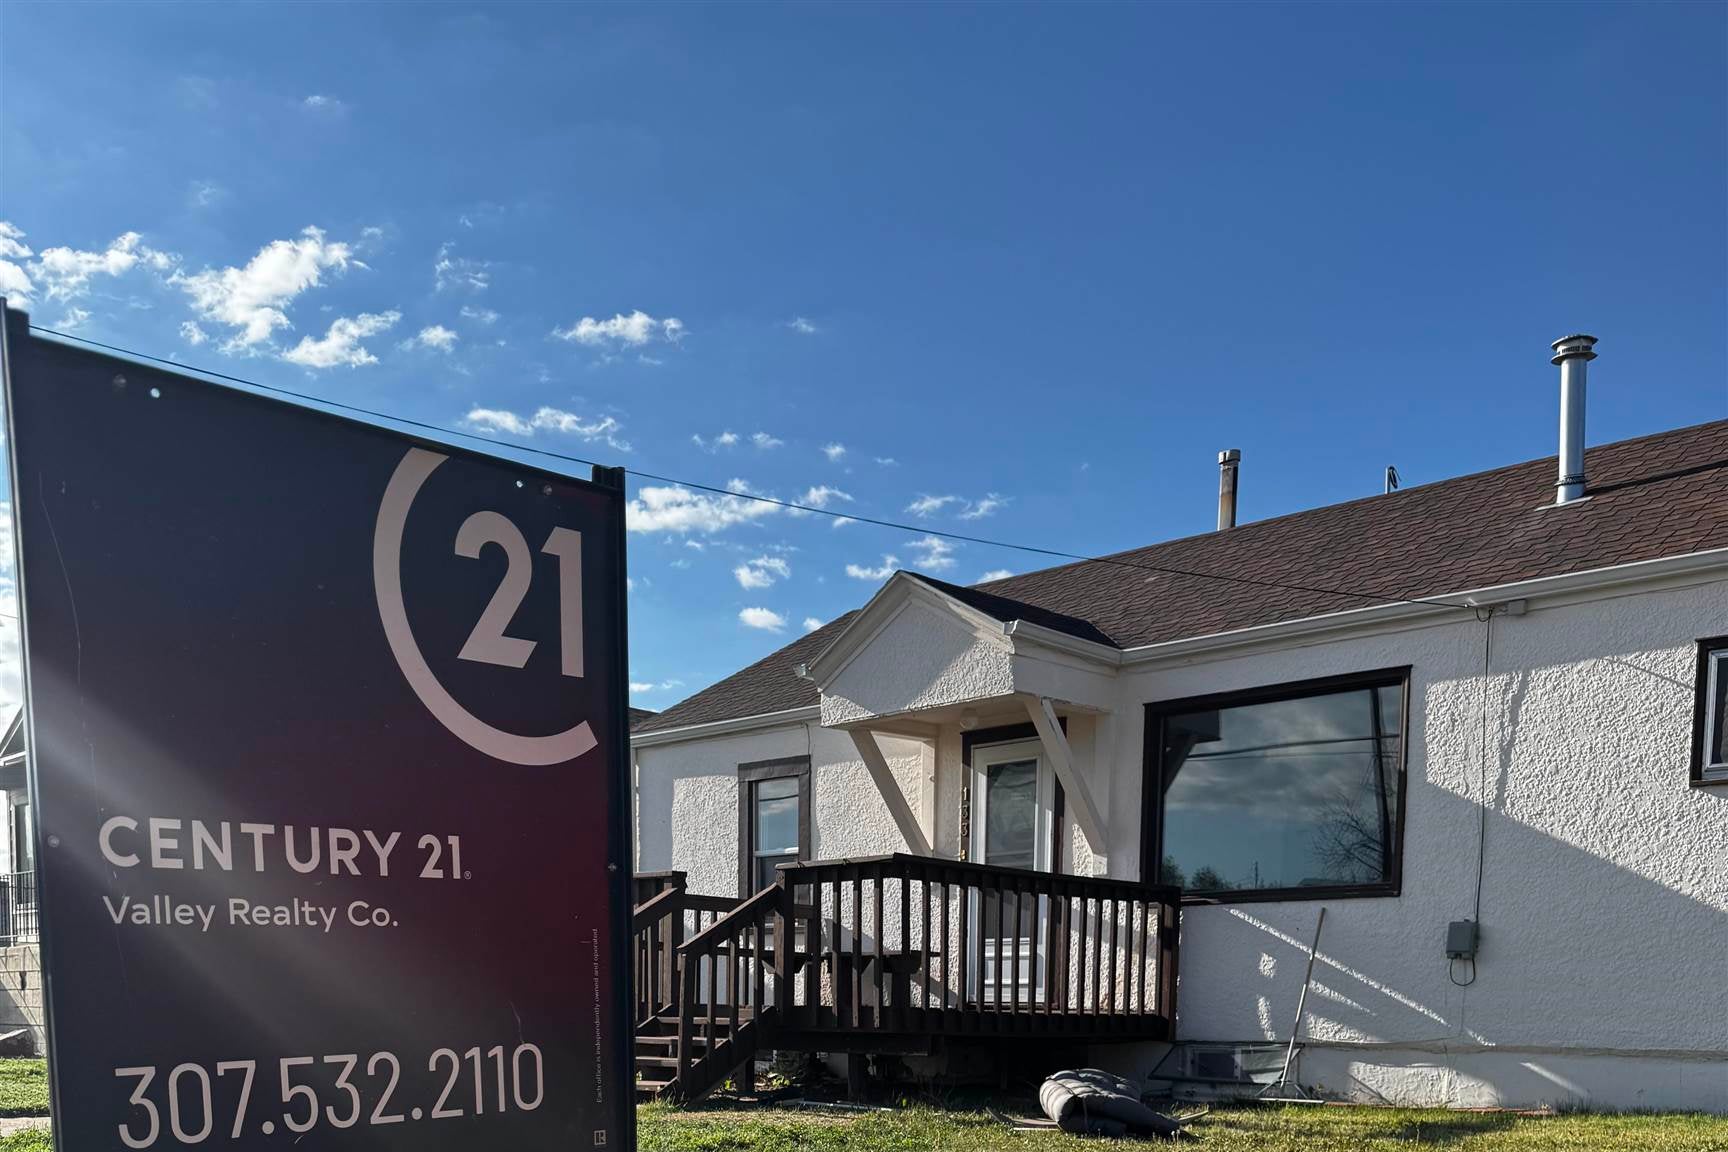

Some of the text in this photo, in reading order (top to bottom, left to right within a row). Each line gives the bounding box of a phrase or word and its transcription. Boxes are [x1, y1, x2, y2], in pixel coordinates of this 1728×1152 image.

[99, 815, 401, 877] CENTURY
[102, 895, 399, 932] Valley Realty Co.
[115, 1042, 544, 1149] 307.532.2110
